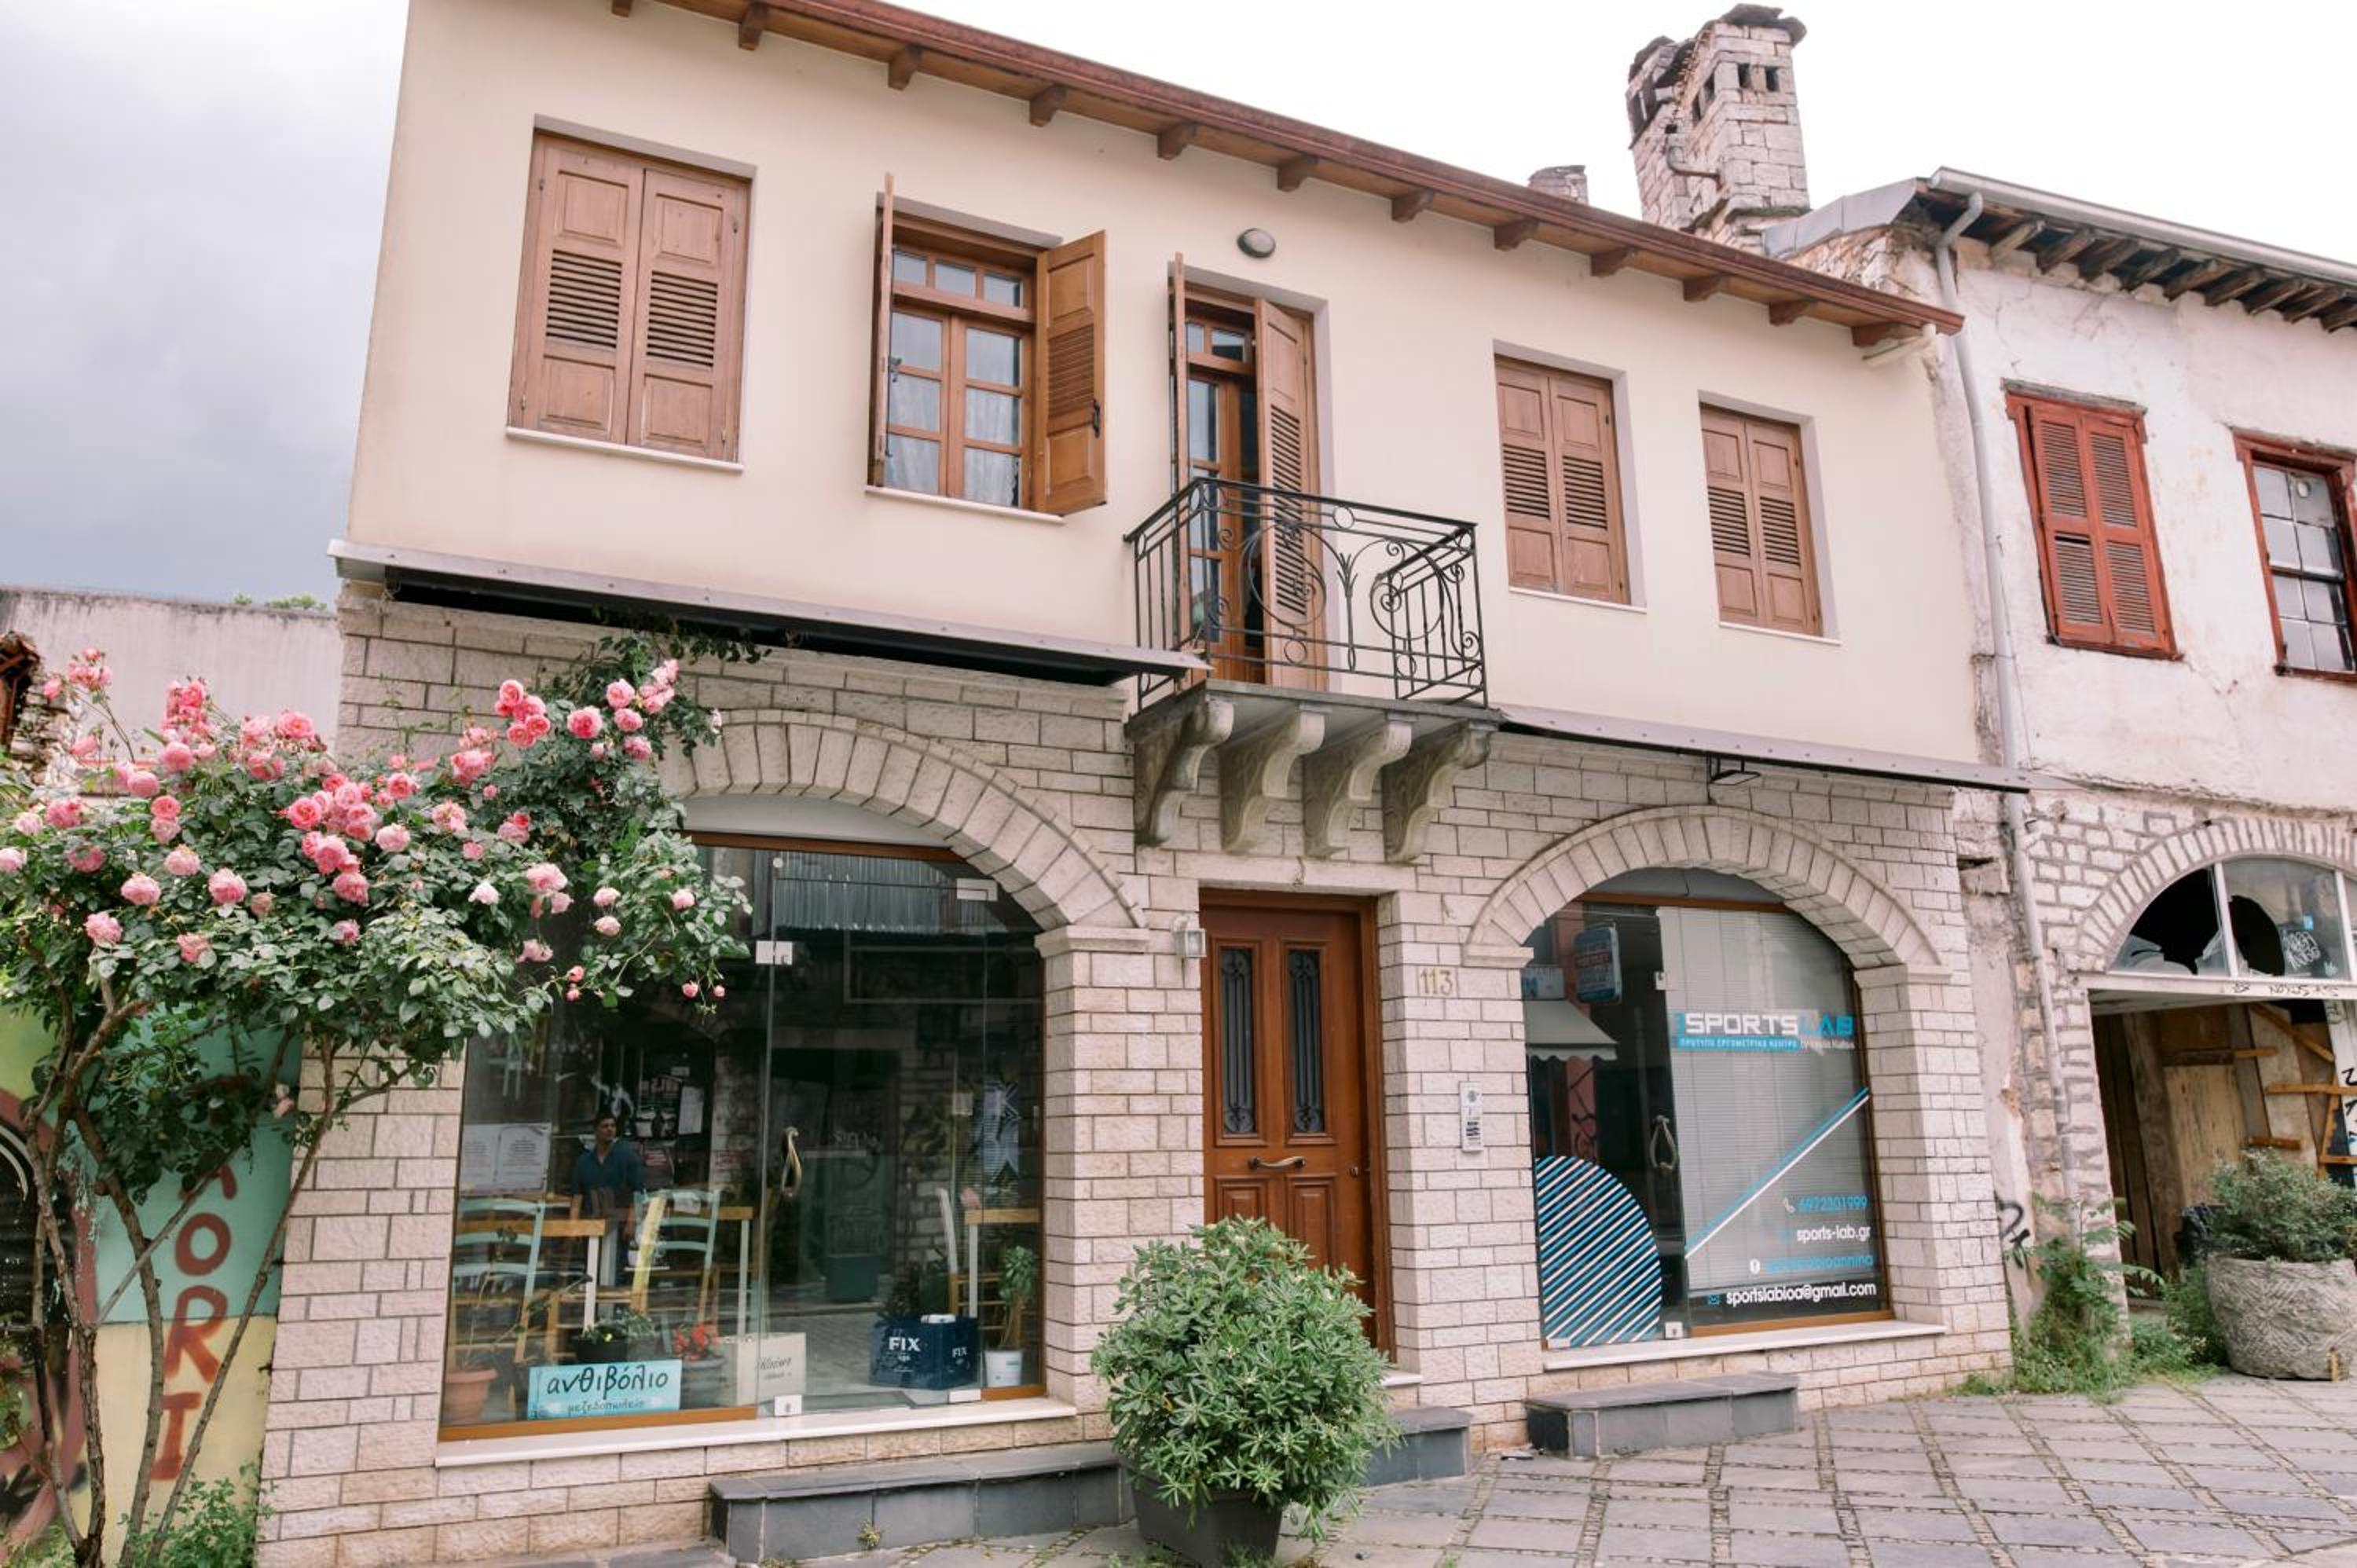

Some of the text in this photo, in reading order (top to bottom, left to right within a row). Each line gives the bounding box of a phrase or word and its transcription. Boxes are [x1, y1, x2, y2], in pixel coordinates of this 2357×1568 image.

[1420, 969, 1453, 996] 113
[1797, 1224, 1871, 1244] sports-lab.gr
[1726, 1281, 1877, 1307] sportslabioa@gmail.com
[889, 1336, 921, 1352] FIX
[952, 1346, 968, 1358] FIX
